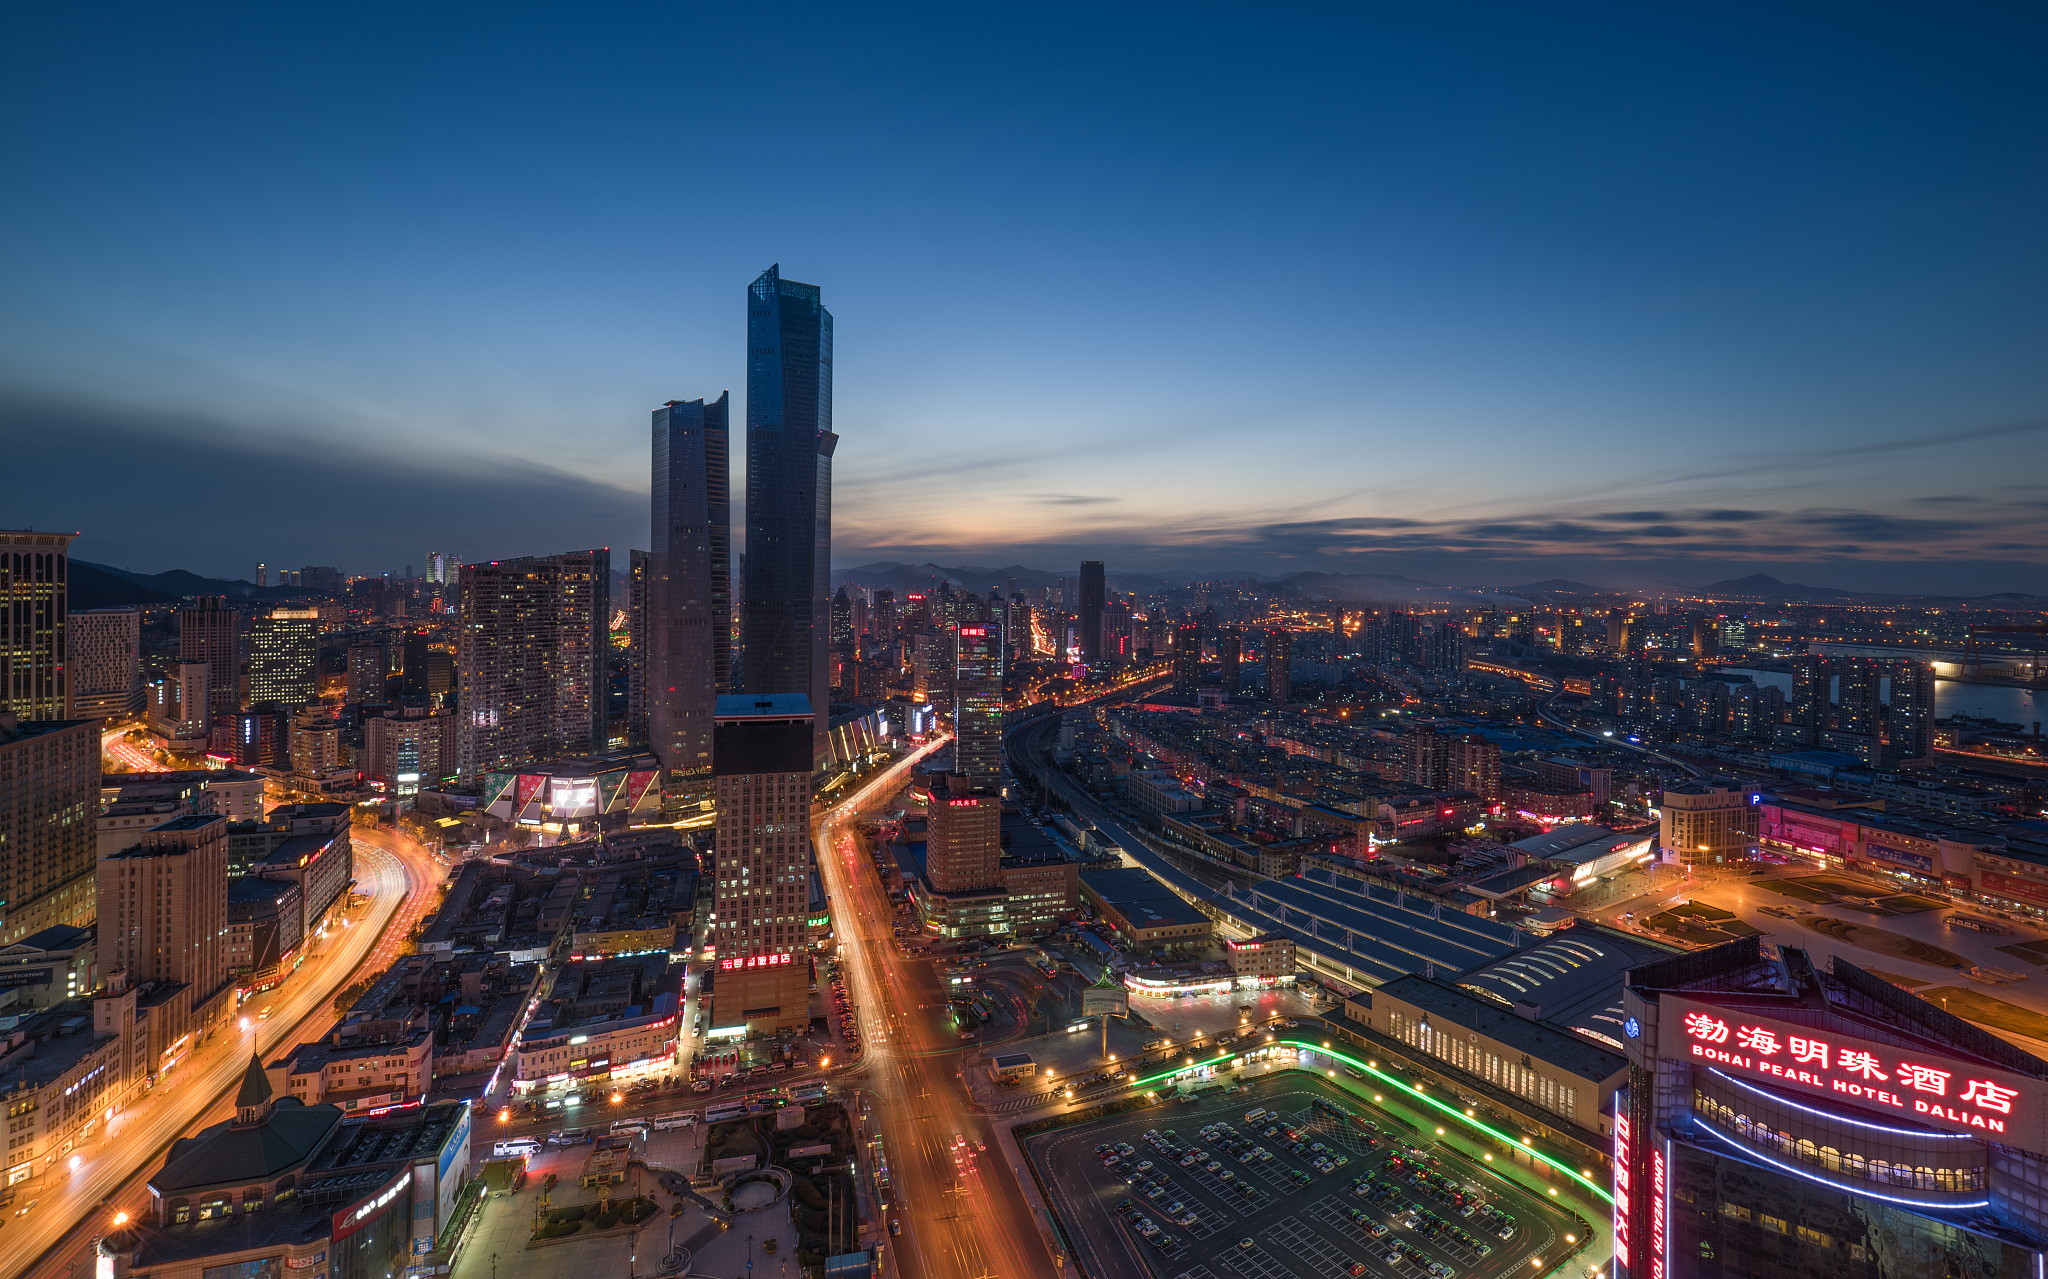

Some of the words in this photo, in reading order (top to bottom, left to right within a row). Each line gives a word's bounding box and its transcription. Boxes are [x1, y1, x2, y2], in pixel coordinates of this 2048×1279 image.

[1753, 795, 1760, 805] P
[1684, 1012, 2019, 1114] 渤海明珠酒店
[1692, 1044, 1751, 1068] BOHAI
[1759, 1061, 1824, 1087] PEARL
[1833, 1079, 1903, 1107] HOTEL
[1915, 1100, 2005, 1132] DALIAN
[1654, 1150, 1664, 1194] JUHUI
[1653, 1195, 1664, 1255] WEALTH
